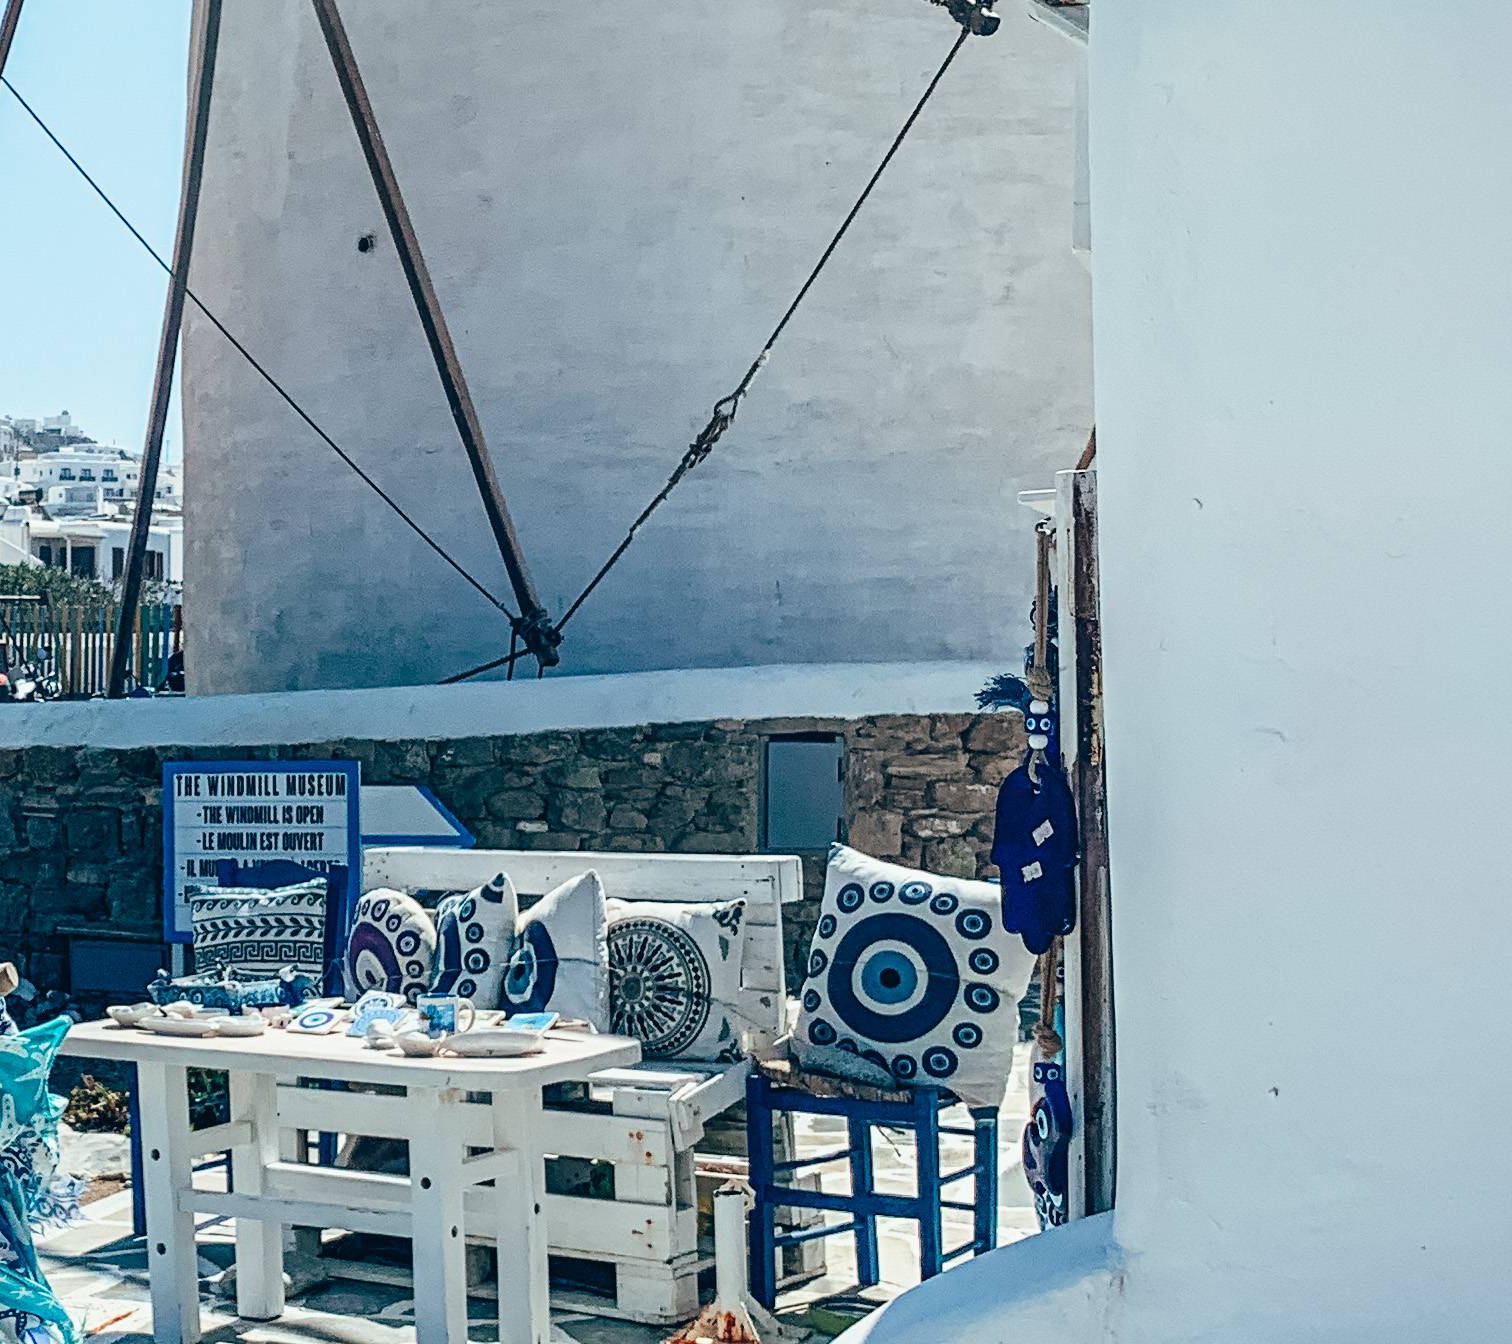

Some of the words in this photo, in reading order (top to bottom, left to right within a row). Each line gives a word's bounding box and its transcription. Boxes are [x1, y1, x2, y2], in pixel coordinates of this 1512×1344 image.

[175, 774, 201, 797] THE
[207, 774, 280, 797] WINDMILL
[286, 774, 346, 797] MUSEUM
[225, 805, 280, 825] WINDMILL
[282, 805, 293, 824] IS
[295, 805, 324, 824] OPEN
[216, 832, 258, 851] MOULIN
[260, 832, 280, 851] EST
[282, 832, 325, 851] OUVERT
